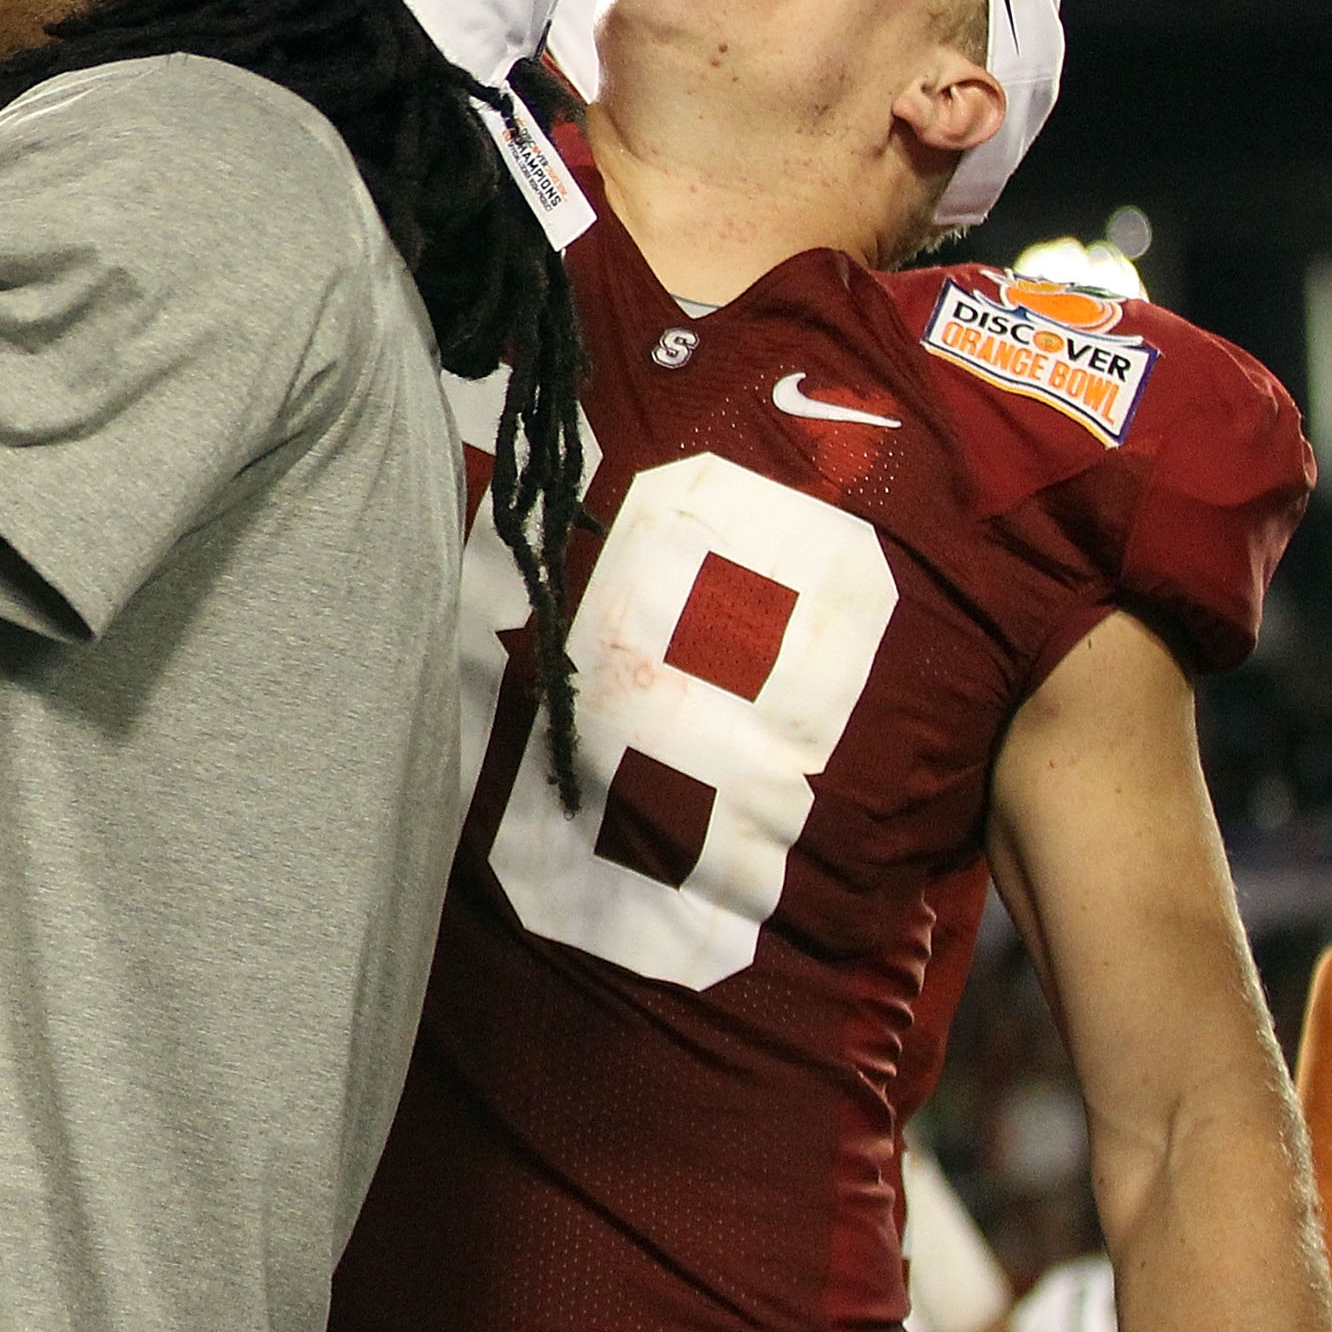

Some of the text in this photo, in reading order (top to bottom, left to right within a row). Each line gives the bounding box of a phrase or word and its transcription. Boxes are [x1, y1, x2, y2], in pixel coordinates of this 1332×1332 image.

[651, 328, 700, 369] S
[941, 321, 1120, 426] ORANGE BOWL
[953, 301, 1132, 382] DISCOVER
